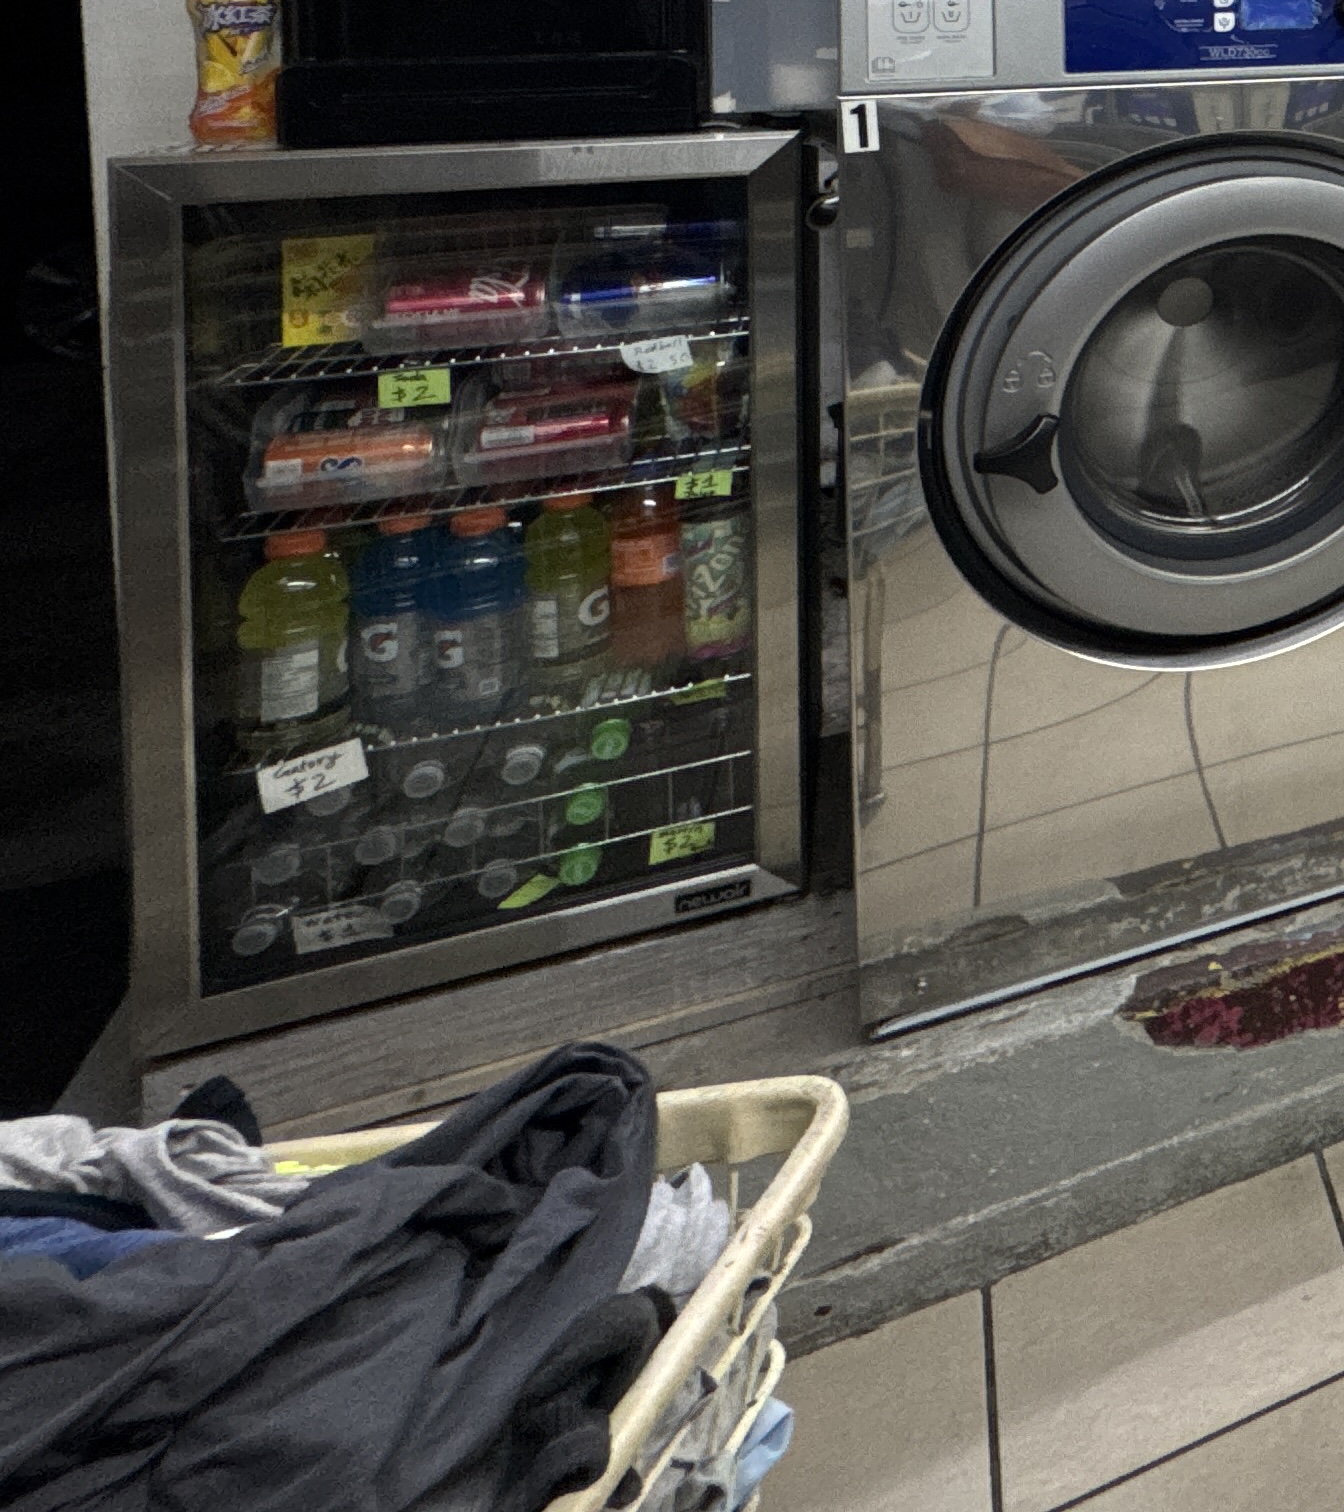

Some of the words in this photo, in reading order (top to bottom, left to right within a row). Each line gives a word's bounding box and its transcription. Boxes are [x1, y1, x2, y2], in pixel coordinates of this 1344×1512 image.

[849, 102, 869, 149] 1
[391, 385, 437, 403] $2
[287, 770, 336, 798] $2
